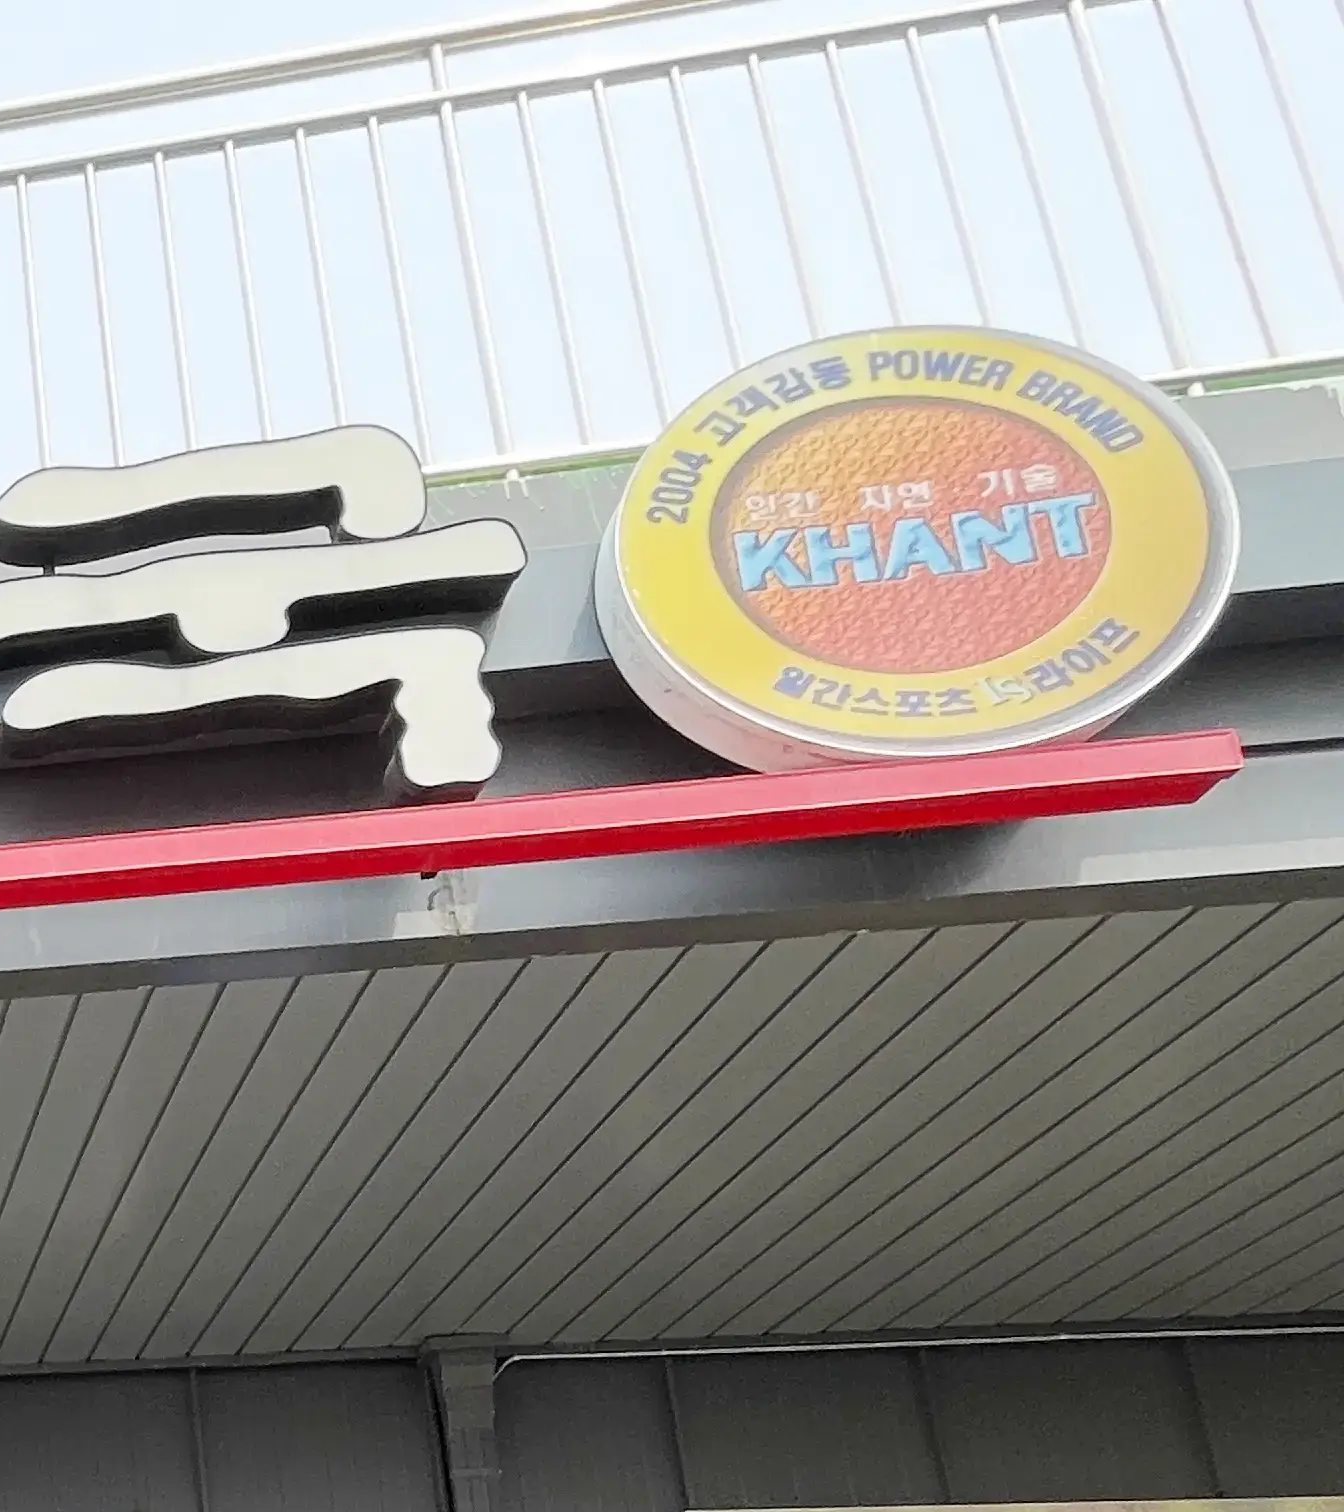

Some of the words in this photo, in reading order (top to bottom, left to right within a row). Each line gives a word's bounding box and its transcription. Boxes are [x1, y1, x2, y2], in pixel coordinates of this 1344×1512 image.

[647, 449, 712, 524] 2004
[867, 350, 1015, 391] POWER
[1016, 370, 1144, 453] BRAND
[745, 491, 820, 521] 인간
[860, 481, 932, 512] 자연
[976, 464, 1058, 498] 기술
[732, 492, 1096, 592] KHANT
[773, 666, 977, 717] 일간스포츠
